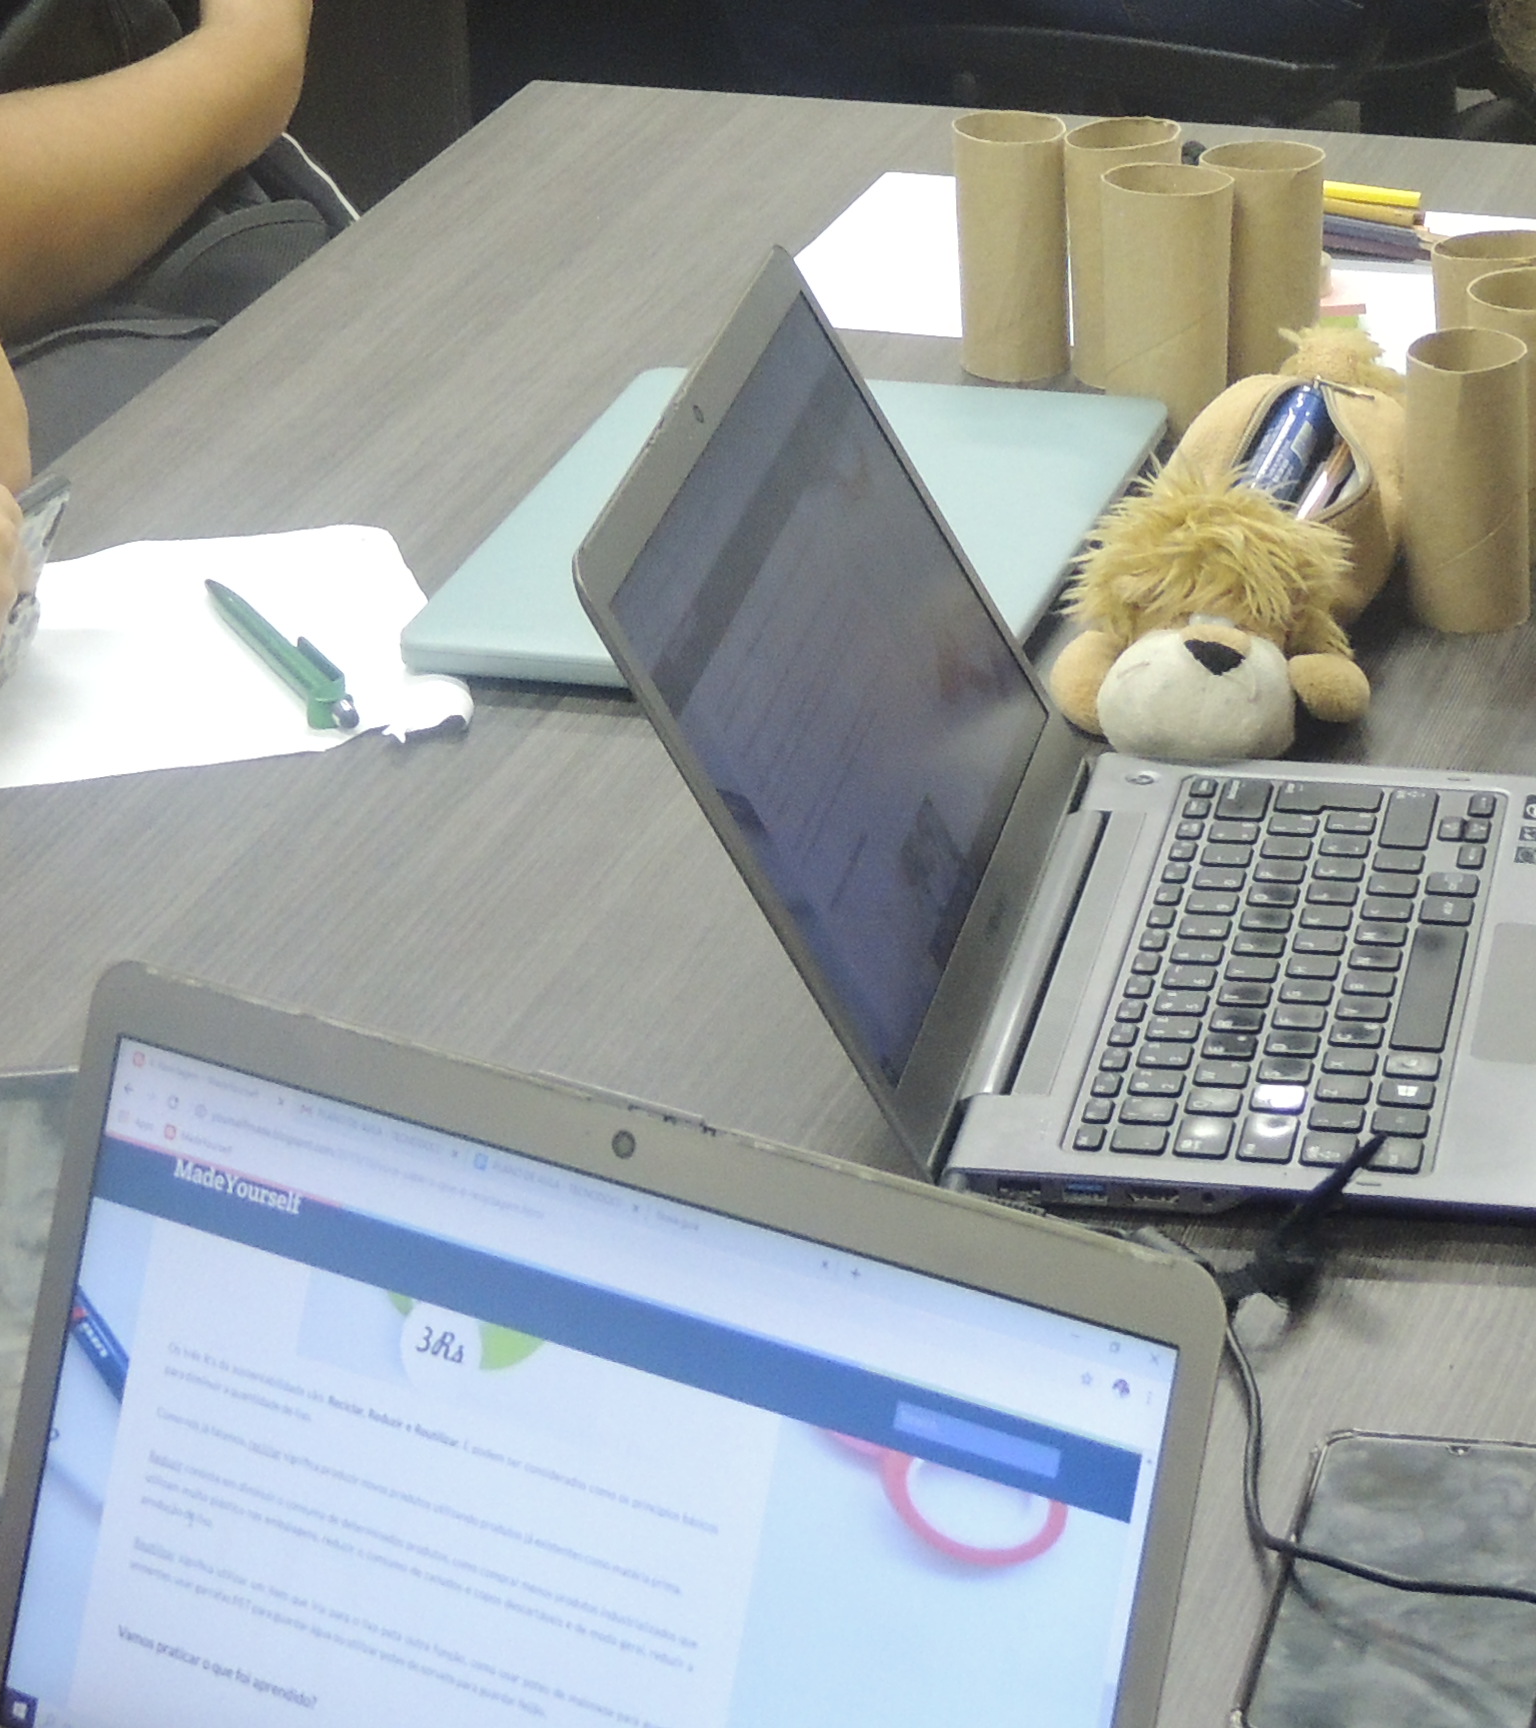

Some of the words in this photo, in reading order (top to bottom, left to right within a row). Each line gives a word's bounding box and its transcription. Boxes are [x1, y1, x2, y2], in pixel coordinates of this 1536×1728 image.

[174, 1157, 303, 1215] MadeYourself
[117, 1624, 155, 1652] Vamos
[155, 1638, 200, 1669] praticar
[201, 1656, 211, 1672] o
[210, 1660, 234, 1681] que
